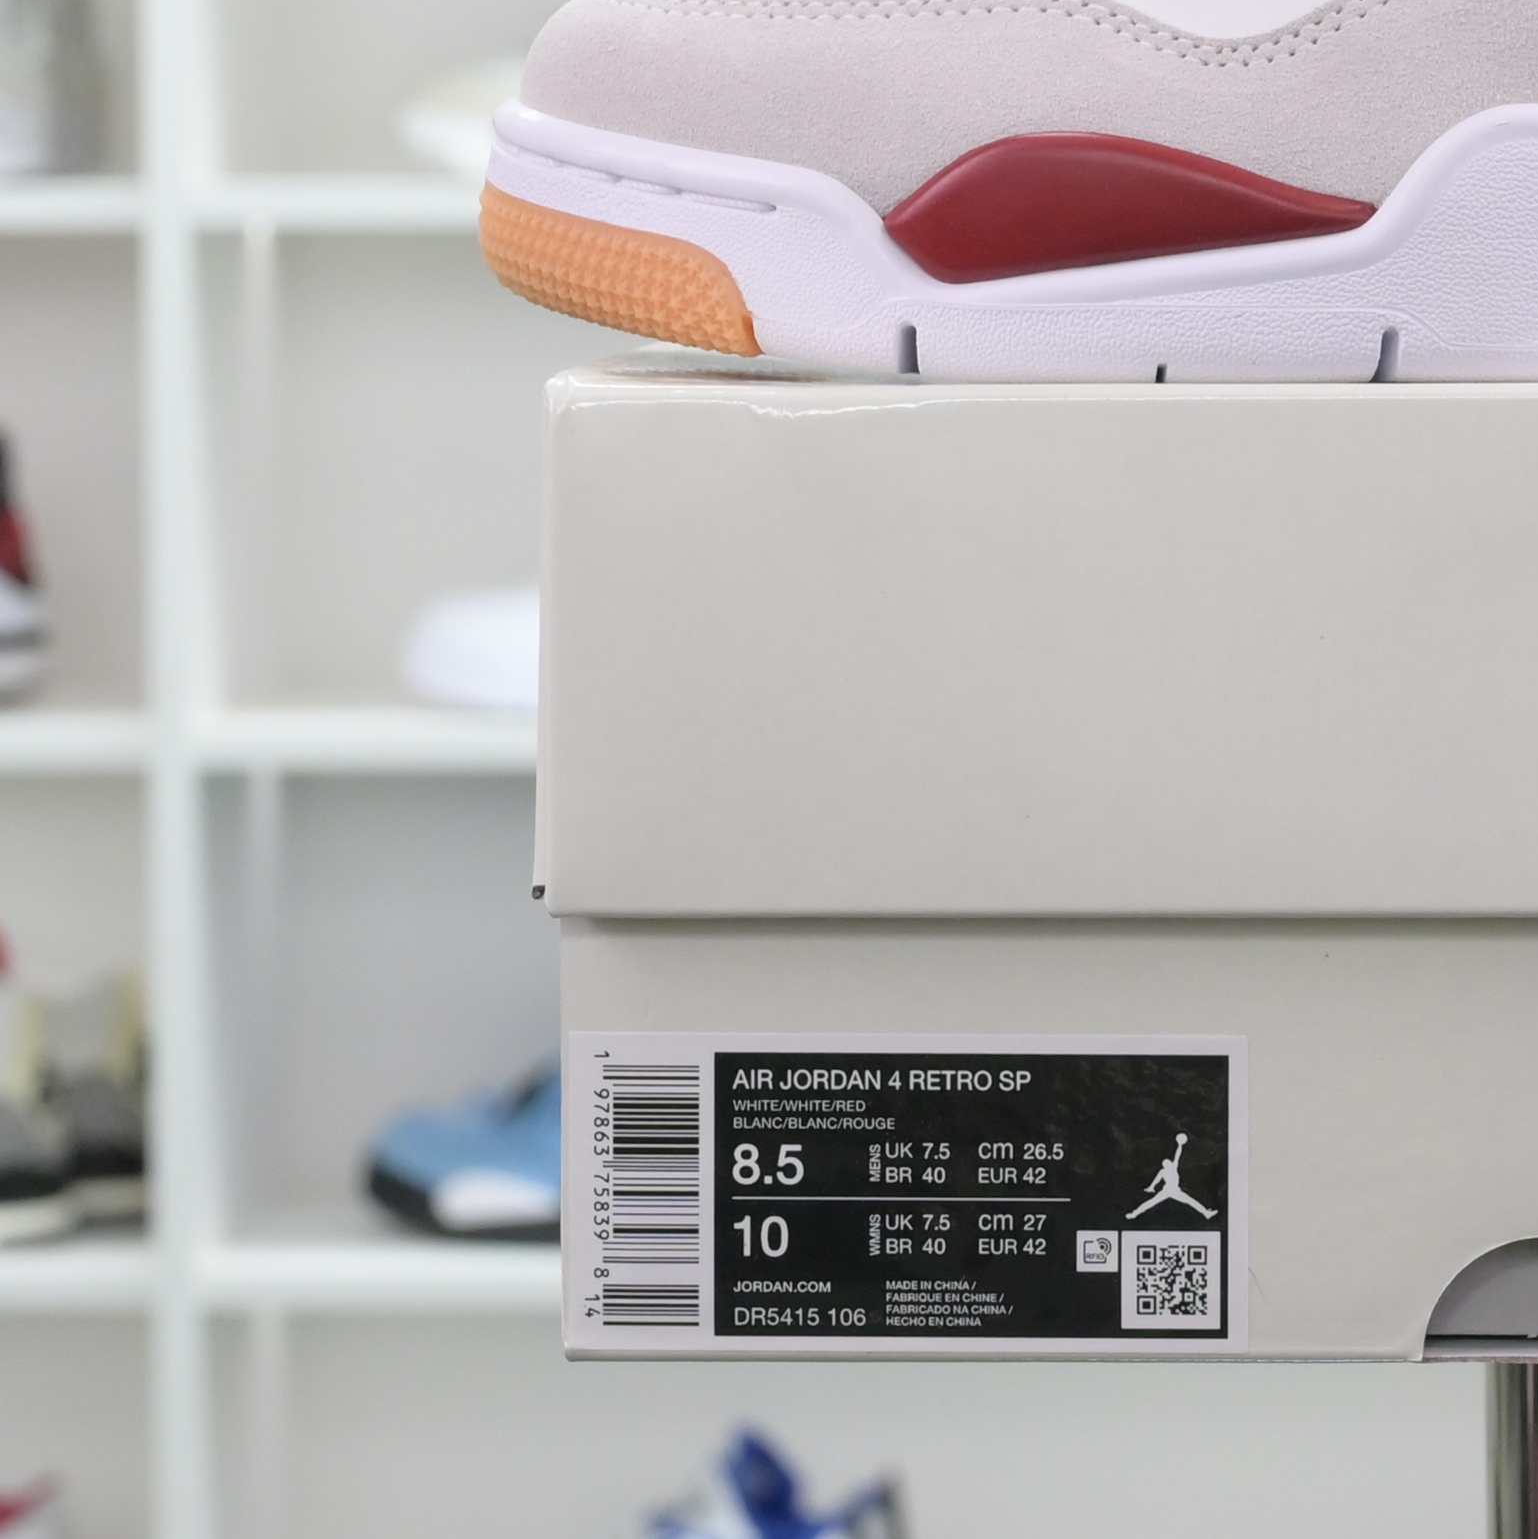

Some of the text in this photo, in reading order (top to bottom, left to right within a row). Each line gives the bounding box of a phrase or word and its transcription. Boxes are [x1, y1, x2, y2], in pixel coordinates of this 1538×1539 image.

[732, 1068, 1032, 1092] AIR JORDAN 4 RETRO SP
[732, 1099, 867, 1112] WHITE/WHITE/RED
[593, 1087, 610, 1156] 97863
[733, 1117, 896, 1130] BLANC/BLANC/ROUGE
[885, 1142, 951, 1160] UK 7.5
[1023, 1142, 1064, 1161] 26.5
[732, 1143, 805, 1186] 8.5
[868, 1143, 882, 1182] MENS
[885, 1166, 946, 1184] BR 40
[978, 1167, 1047, 1184] EUR 42
[593, 1172, 610, 1241] 75839
[885, 1214, 951, 1231] UK 7.5
[1023, 1214, 1047, 1231] 27
[733, 1215, 789, 1258] 10
[868, 1213, 882, 1256] WMNS
[885, 1237, 946, 1255] BR 40
[978, 1237, 1047, 1255] EUR 42
[593, 1267, 610, 1279] 8
[733, 1280, 832, 1293] JORDAN.COM
[886, 1280, 918, 1291] MADE
[920, 1280, 932, 1291] IN
[886, 1293, 942, 1303] FABRIQUE
[945, 1293, 960, 1303] EN
[734, 1307, 867, 1327] DR5415 106
[886, 1305, 951, 1315] FABRICADO
[953, 1305, 969, 1315] NA
[886, 1317, 982, 1327] HECHO EN CHINA
